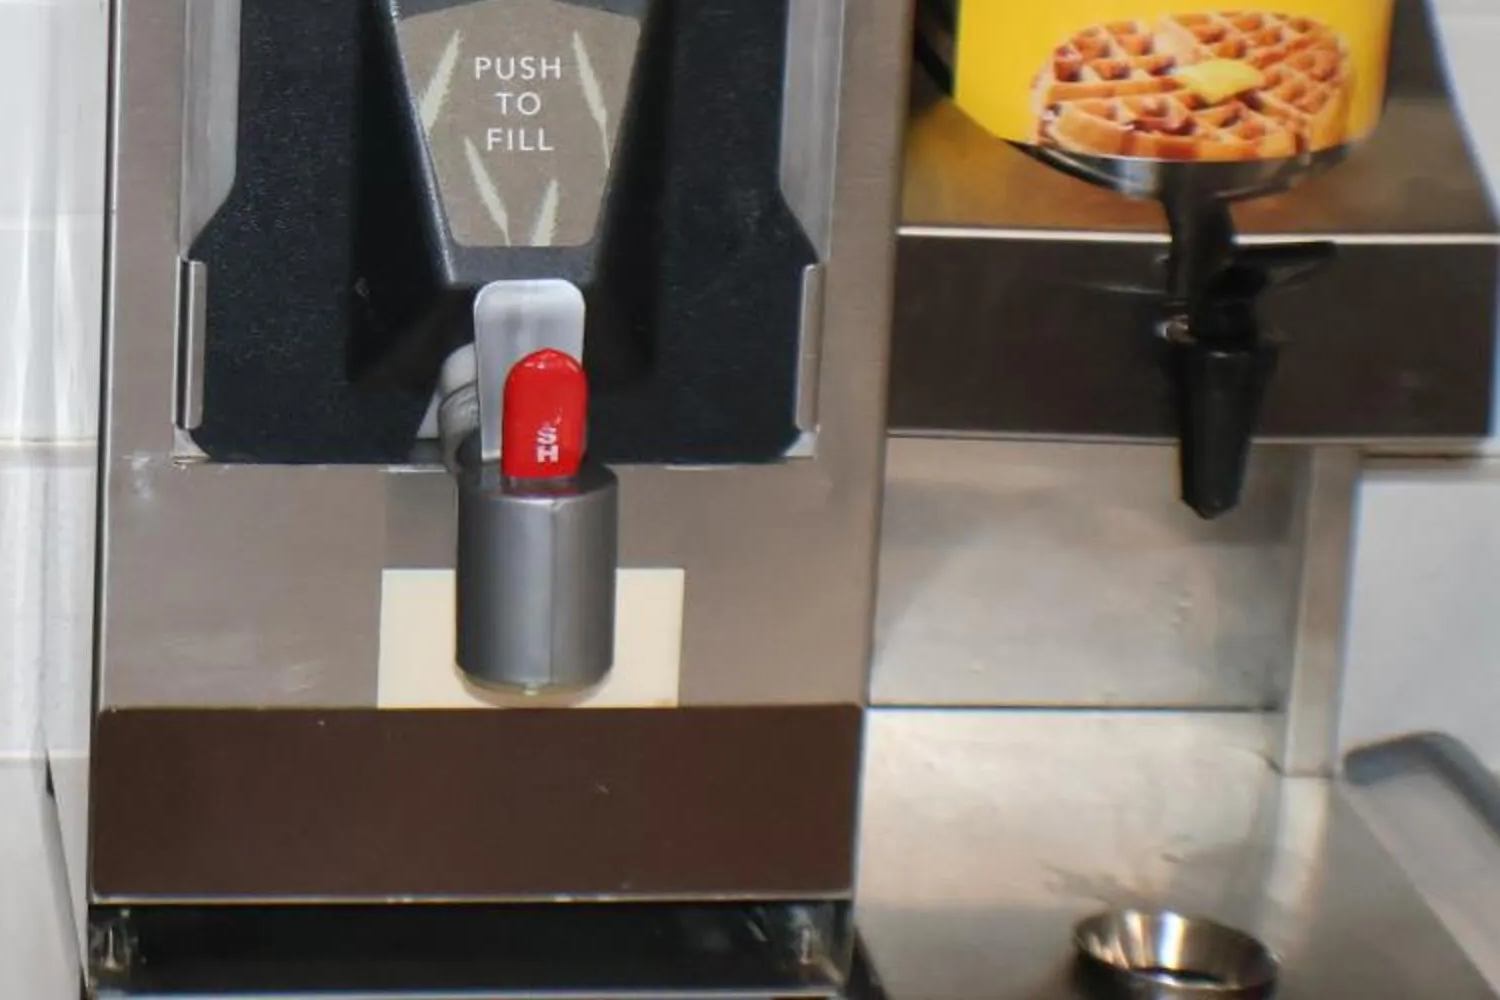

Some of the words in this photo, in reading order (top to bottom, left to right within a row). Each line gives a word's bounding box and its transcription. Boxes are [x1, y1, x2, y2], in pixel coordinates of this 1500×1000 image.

[474, 56, 562, 81] PUSH
[495, 92, 541, 115] TO
[486, 128, 555, 152] FILL
